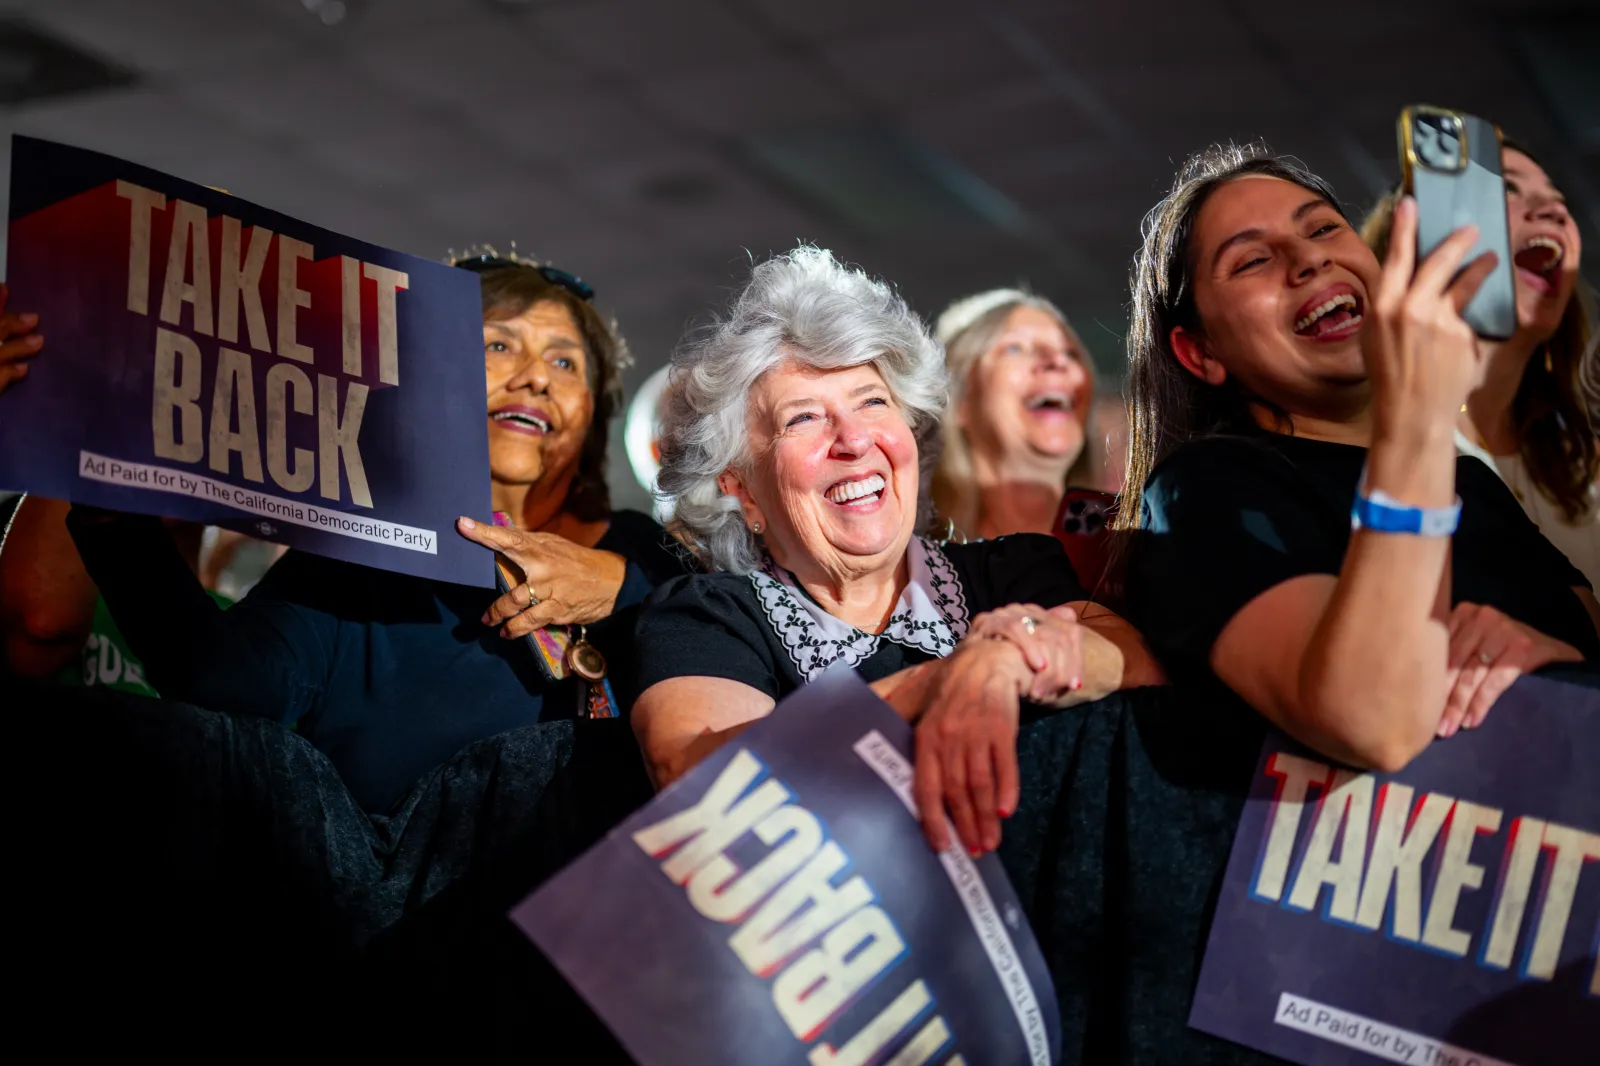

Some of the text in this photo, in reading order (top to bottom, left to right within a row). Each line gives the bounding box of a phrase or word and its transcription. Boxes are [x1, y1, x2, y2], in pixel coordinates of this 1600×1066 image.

[116, 179, 409, 387] TAKE IT
[84, 456, 432, 550] Ad Paid for by The California Democratic Party
[152, 326, 374, 509] BACK
[632, 748, 909, 1043] BACK
[1250, 752, 1600, 981] TAKE IT
[1282, 1001, 1312, 1024] Ad
[1314, 1009, 1360, 1040] Paid
[1362, 1025, 1392, 1048] for
[1393, 1035, 1418, 1062] by
